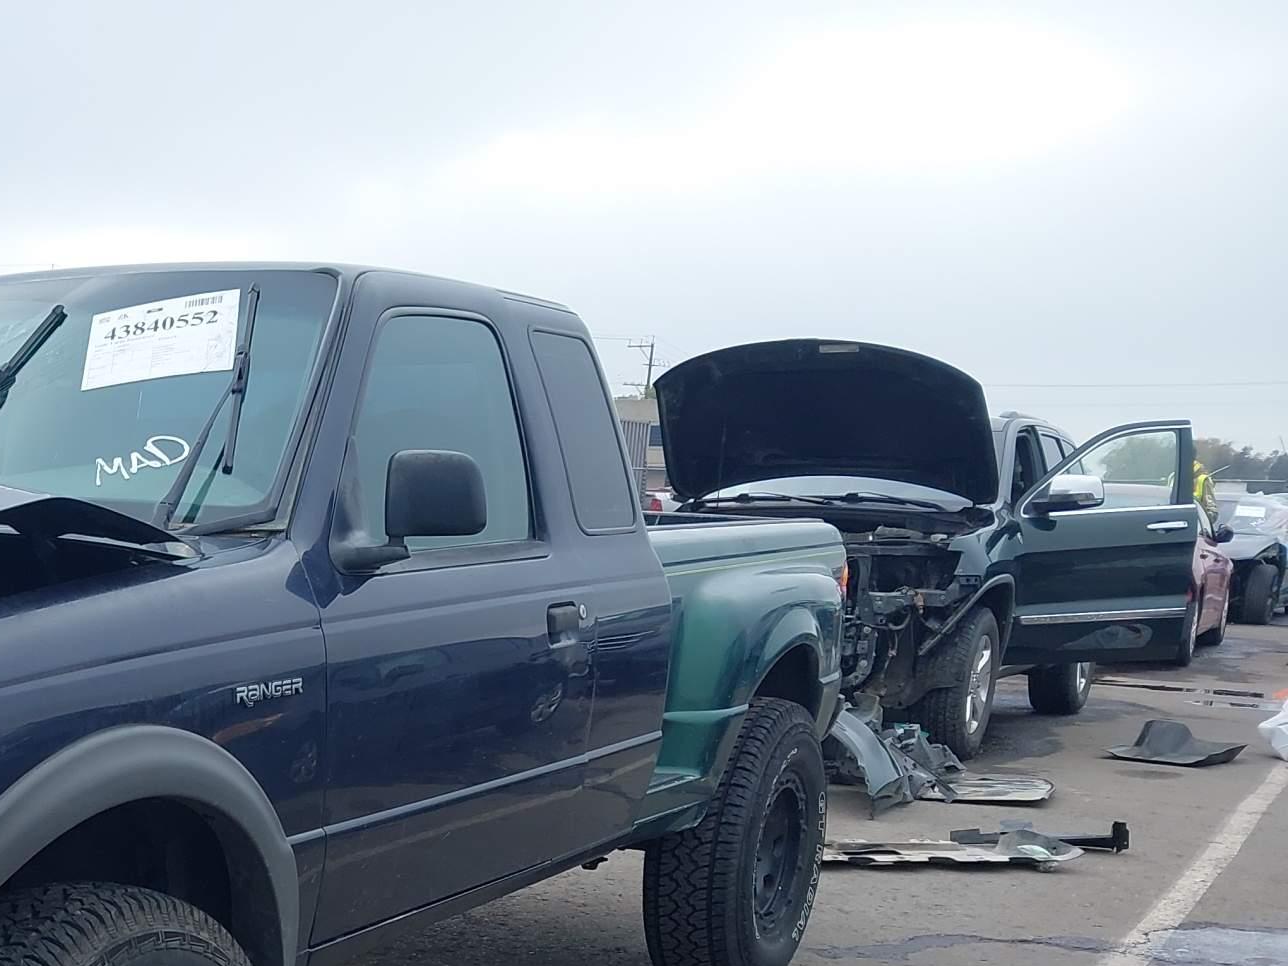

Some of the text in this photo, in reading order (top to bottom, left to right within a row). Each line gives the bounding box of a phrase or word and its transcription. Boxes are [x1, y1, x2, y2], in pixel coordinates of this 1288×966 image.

[104, 309, 219, 341] 43840552
[95, 435, 191, 487] MAD
[236, 677, 304, 708] RANGER
